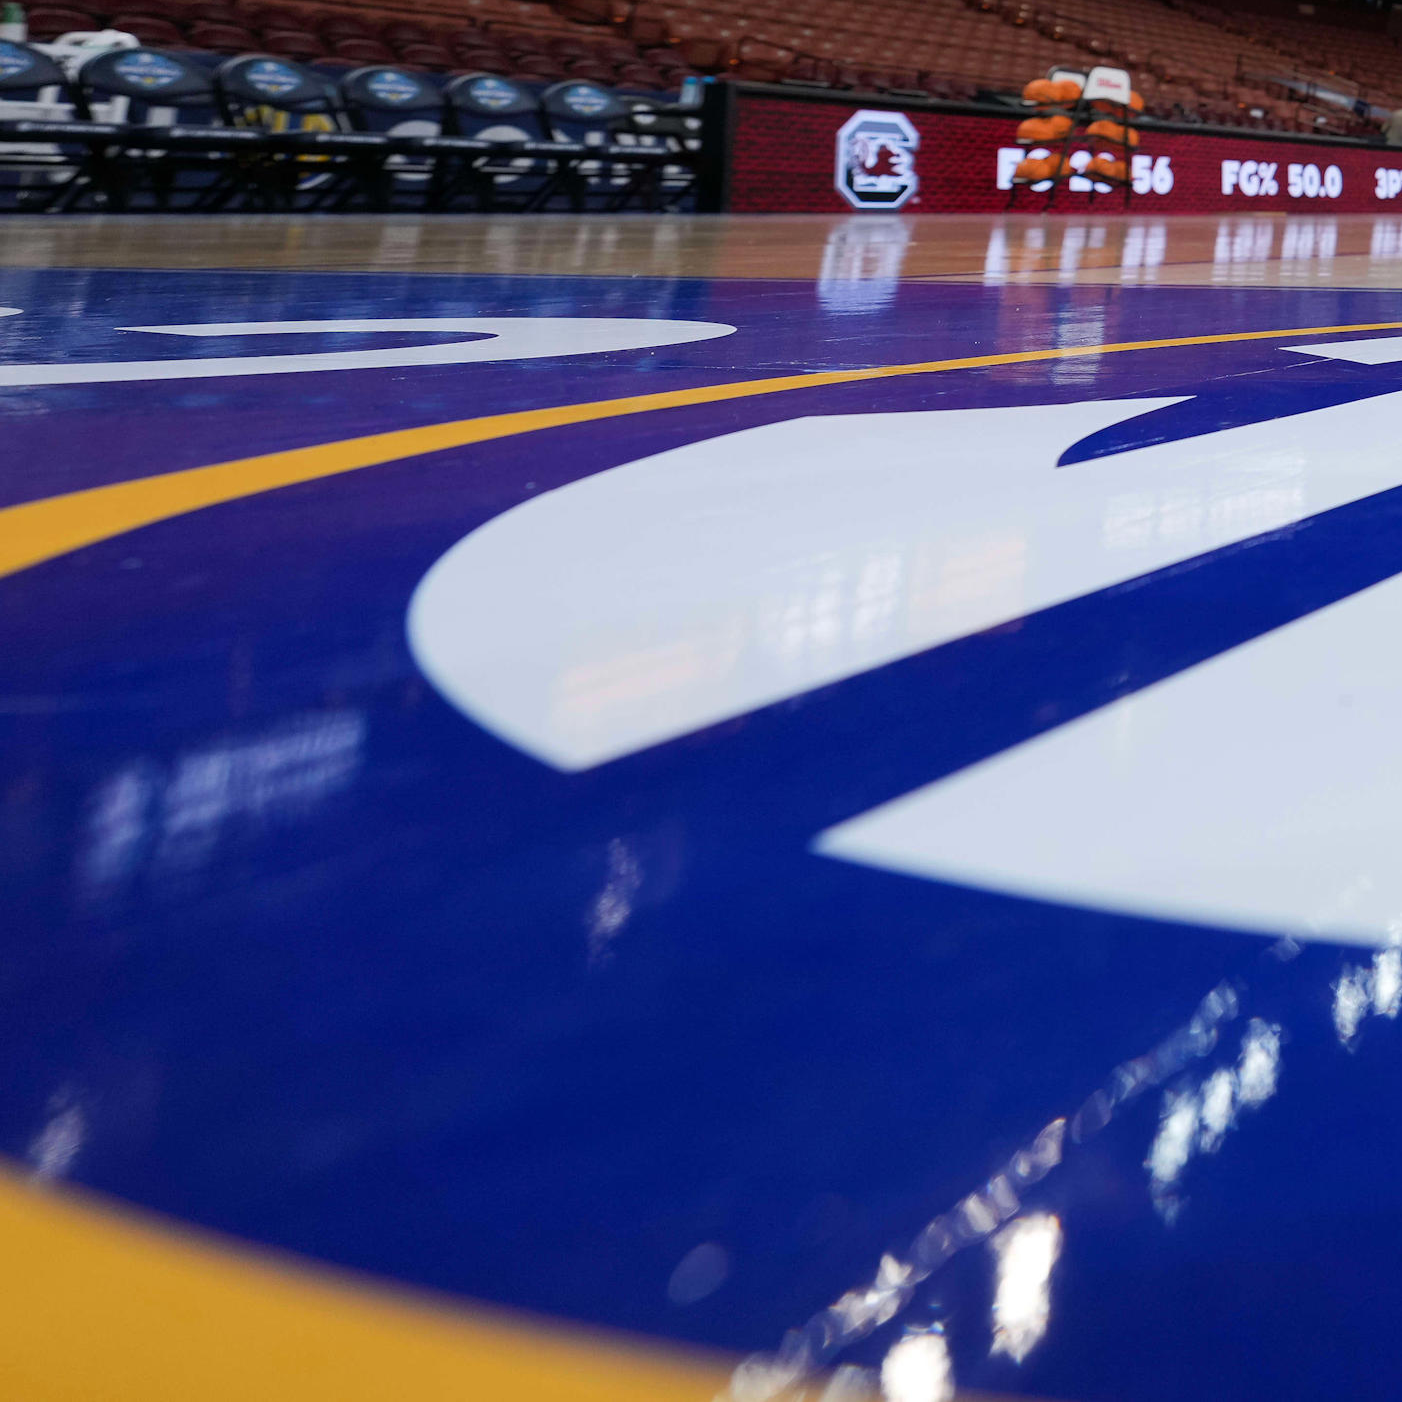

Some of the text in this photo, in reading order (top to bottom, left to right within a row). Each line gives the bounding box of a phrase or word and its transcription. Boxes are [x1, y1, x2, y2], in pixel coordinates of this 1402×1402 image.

[1067, 149, 1175, 196] 256
[1220, 158, 1279, 198] FG%
[1287, 162, 1344, 199] 50.0
